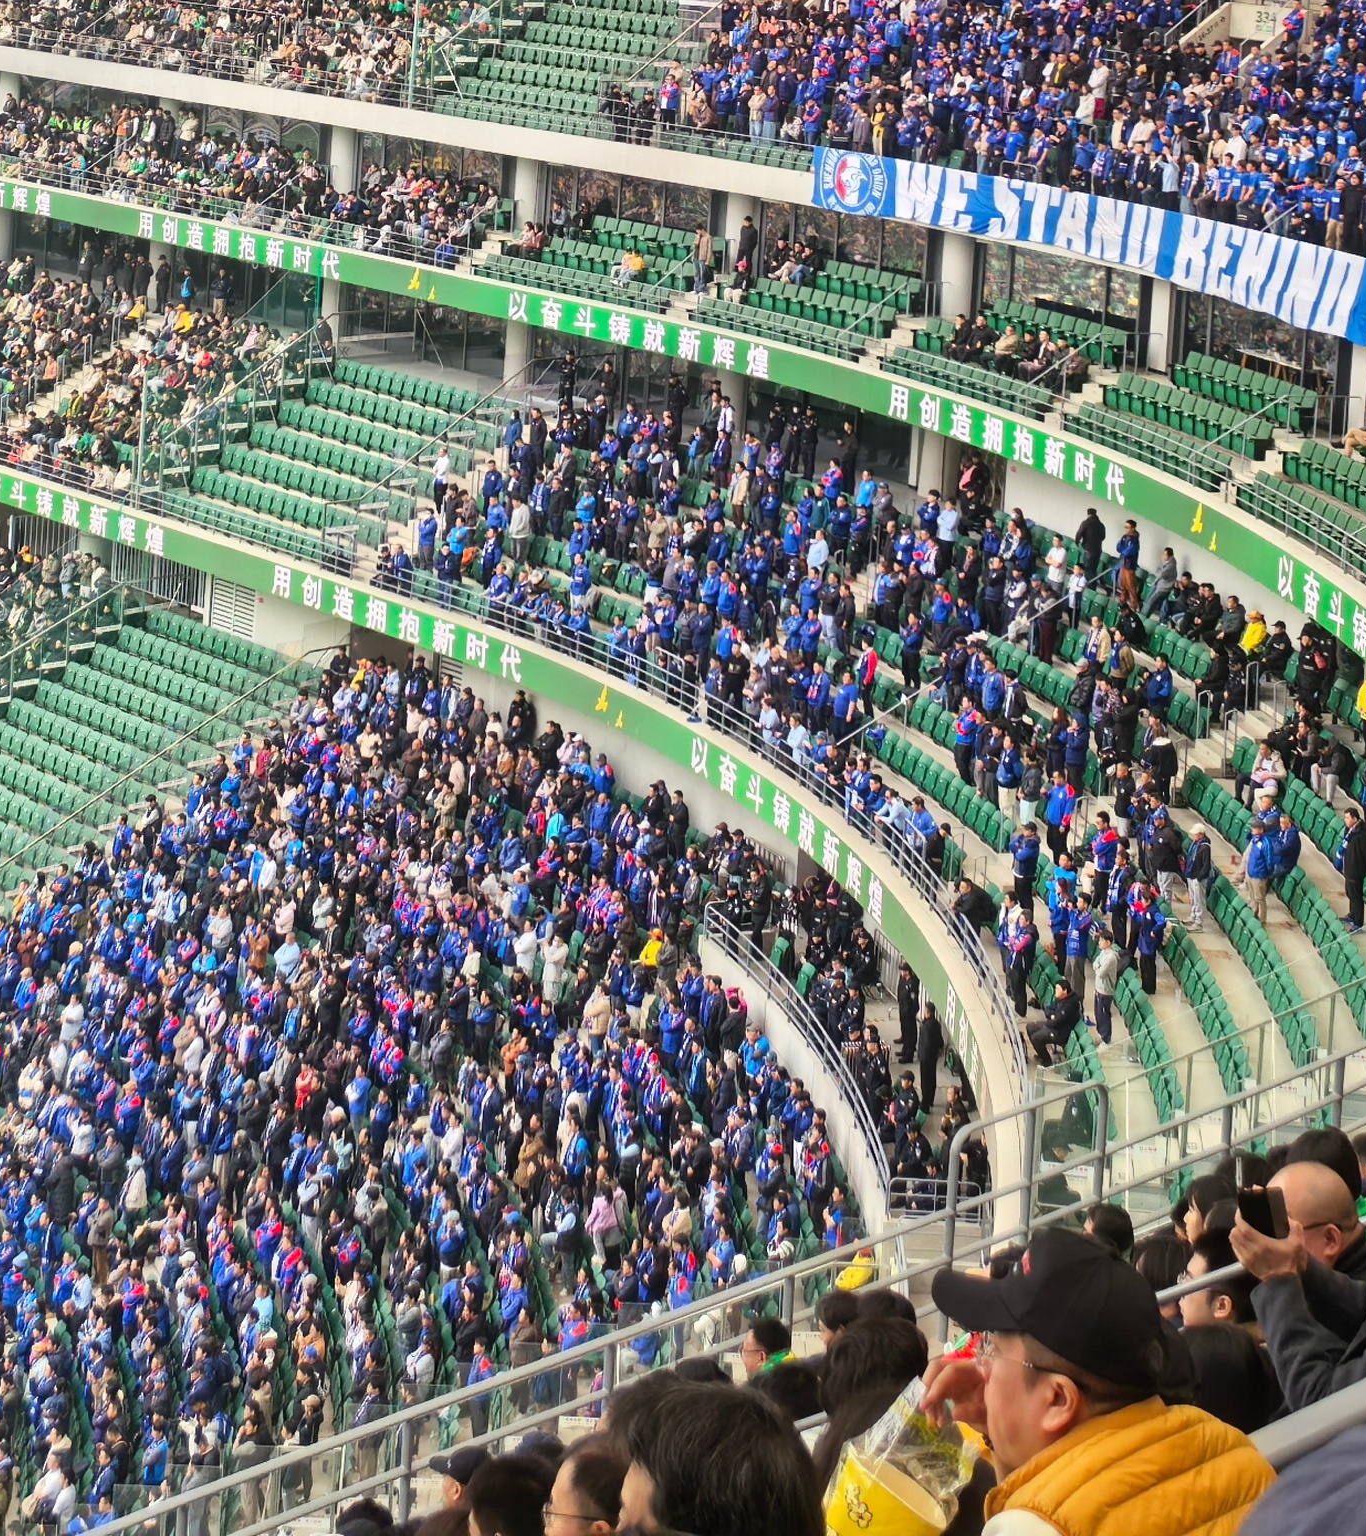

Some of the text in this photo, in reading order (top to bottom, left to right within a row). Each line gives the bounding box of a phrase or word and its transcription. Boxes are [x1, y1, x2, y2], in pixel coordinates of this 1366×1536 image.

[137, 212, 340, 280] 用创造拥抱新时代
[896, 161, 975, 231] WE
[988, 178, 1165, 276] STAND
[1173, 214, 1354, 335] BEHIND
[507, 291, 770, 379] 以奋斗铸就新辉煌
[887, 381, 1126, 506] 用创造拥抱新时代
[272, 564, 523, 683] 用创造拥抱新时代
[689, 735, 885, 926] 以奋斗铸就新辉煌
